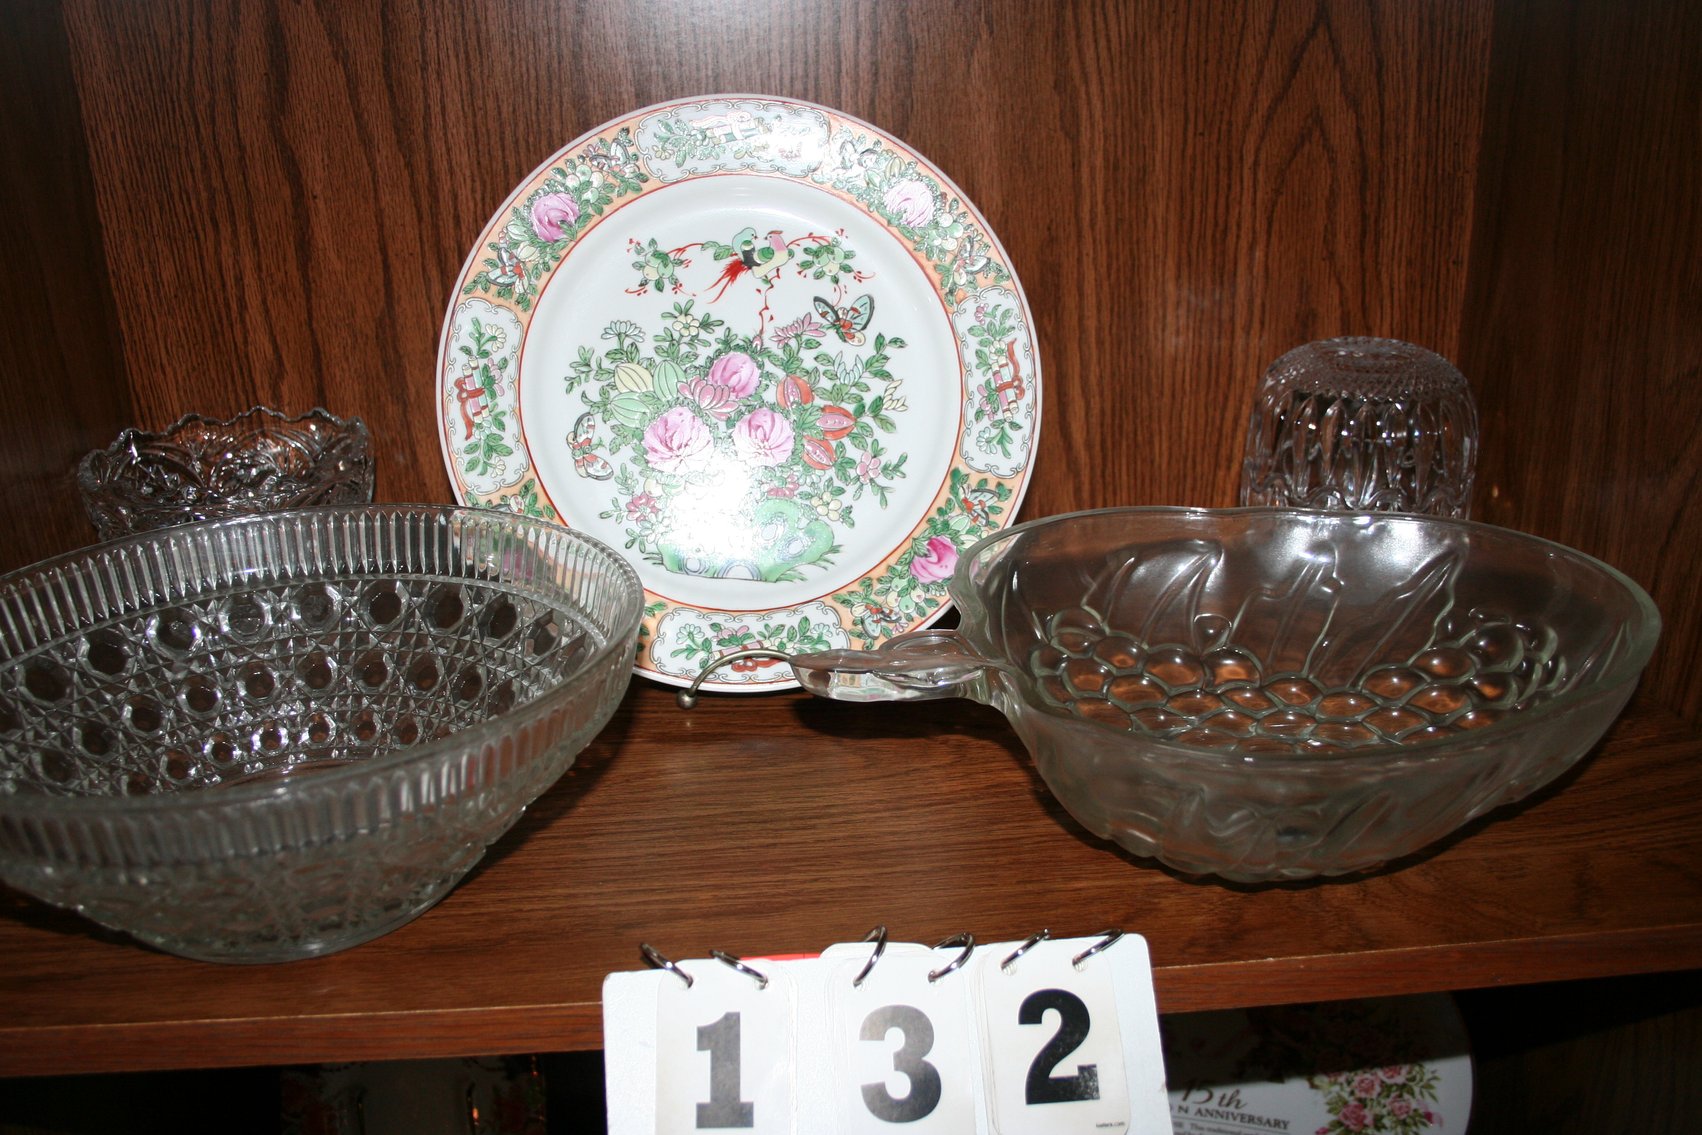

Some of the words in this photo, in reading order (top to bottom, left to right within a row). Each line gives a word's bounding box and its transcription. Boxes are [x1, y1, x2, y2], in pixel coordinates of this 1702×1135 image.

[696, 1012, 755, 1128] 1
[858, 1004, 942, 1123] 3
[1018, 988, 1100, 1105] 2
[1194, 1106, 1290, 1130] ANNIVERSARY
